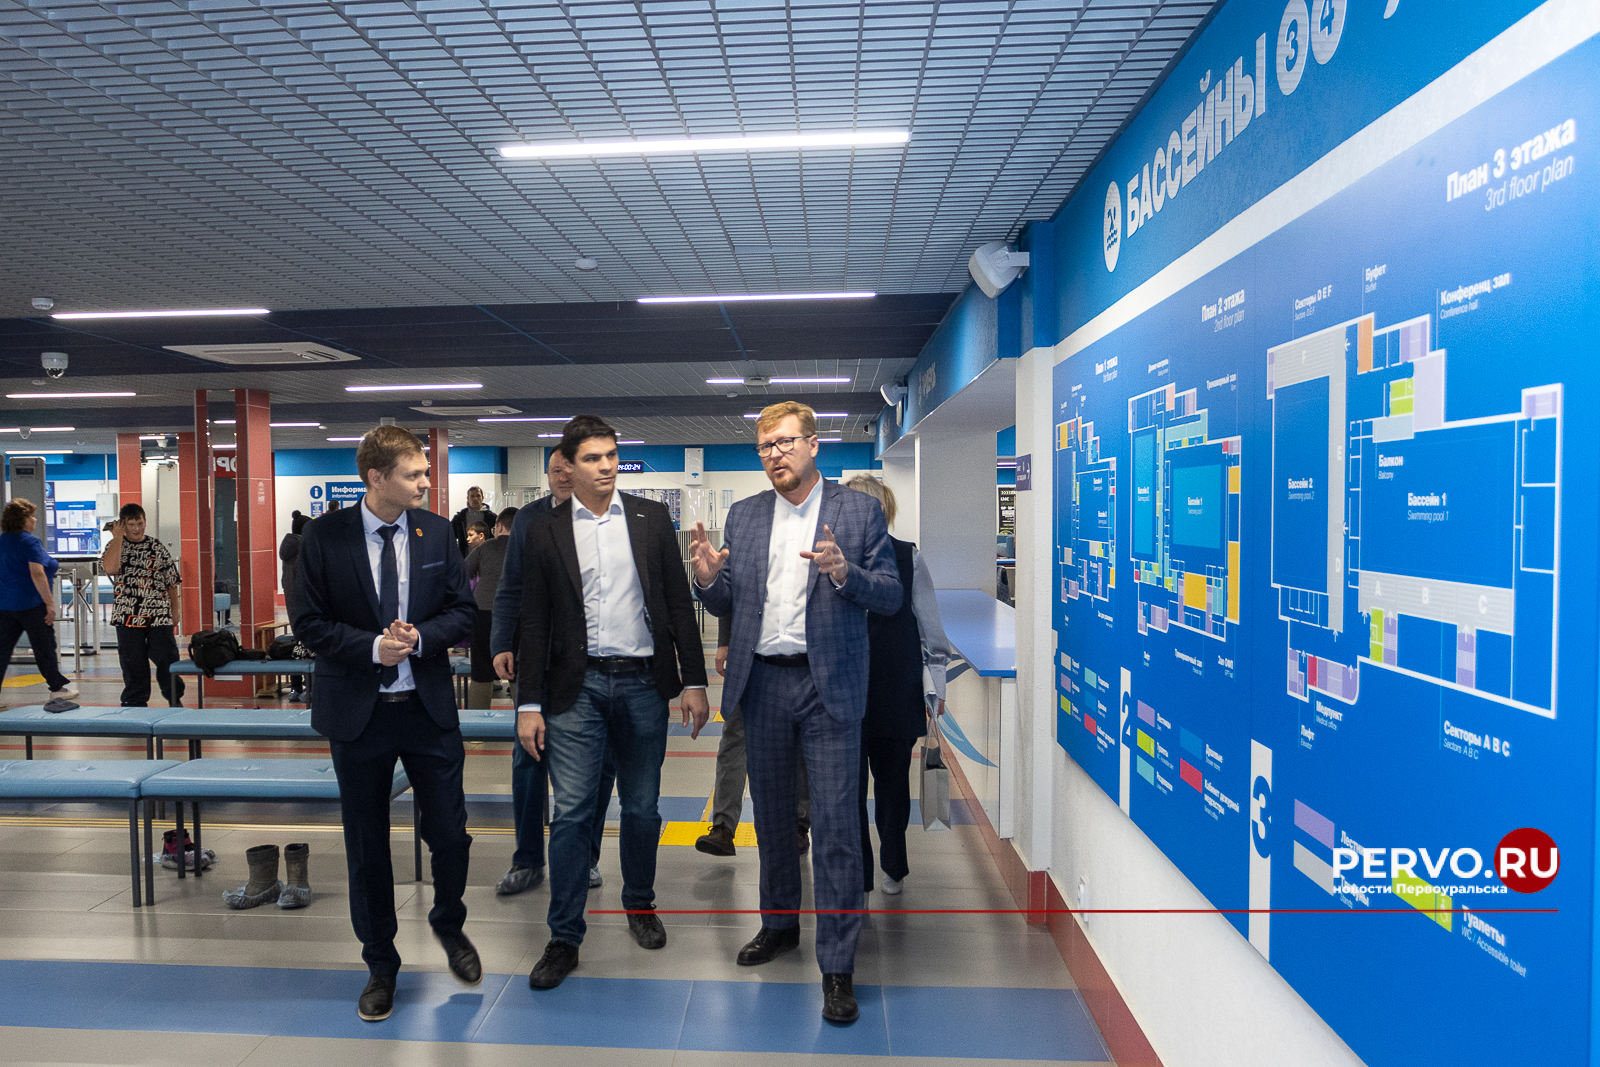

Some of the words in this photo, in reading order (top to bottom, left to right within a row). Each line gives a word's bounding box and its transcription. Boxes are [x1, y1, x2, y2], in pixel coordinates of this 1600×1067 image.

[1127, 32, 1266, 239] БАССЕЙНЫ
[1446, 163, 1488, 202] План
[1492, 148, 1506, 178] 3
[1510, 118, 1576, 170] этажа
[1484, 186, 1506, 212] 3rd
[1508, 172, 1539, 204] floor
[1542, 155, 1574, 193] plan
[1365, 264, 1386, 282] Буфет
[1440, 279, 1491, 306] Конференц
[1492, 272, 1510, 289] зал
[1202, 304, 1217, 322] План
[1218, 296, 1223, 314] 2
[1224, 289, 1245, 312] этажа
[1318, 289, 1322, 302] D
[1323, 286, 1327, 299] E
[1328, 284, 1332, 297] F
[1378, 454, 1404, 468] Балкон
[1309, 478, 1313, 488] 2
[1408, 492, 1440, 506] Бассейн
[1442, 492, 1447, 506] 1
[1446, 510, 1449, 521] 1
[1335, 557, 1341, 572] D
[1374, 580, 1382, 597] A
[1422, 587, 1430, 604] B
[1478, 594, 1487, 614] C
[1443, 738, 1462, 754] Sectors
[1463, 746, 1468, 756] A
[1468, 748, 1473, 758] B
[1474, 750, 1479, 760] C
[1444, 720, 1482, 746] Секторы
[1483, 734, 1491, 750] A
[1492, 736, 1500, 754] B
[1502, 740, 1511, 757] C
[1462, 904, 1506, 947] Туалеты
[1461, 925, 1472, 941] WC
[1510, 958, 1527, 978] toilet
